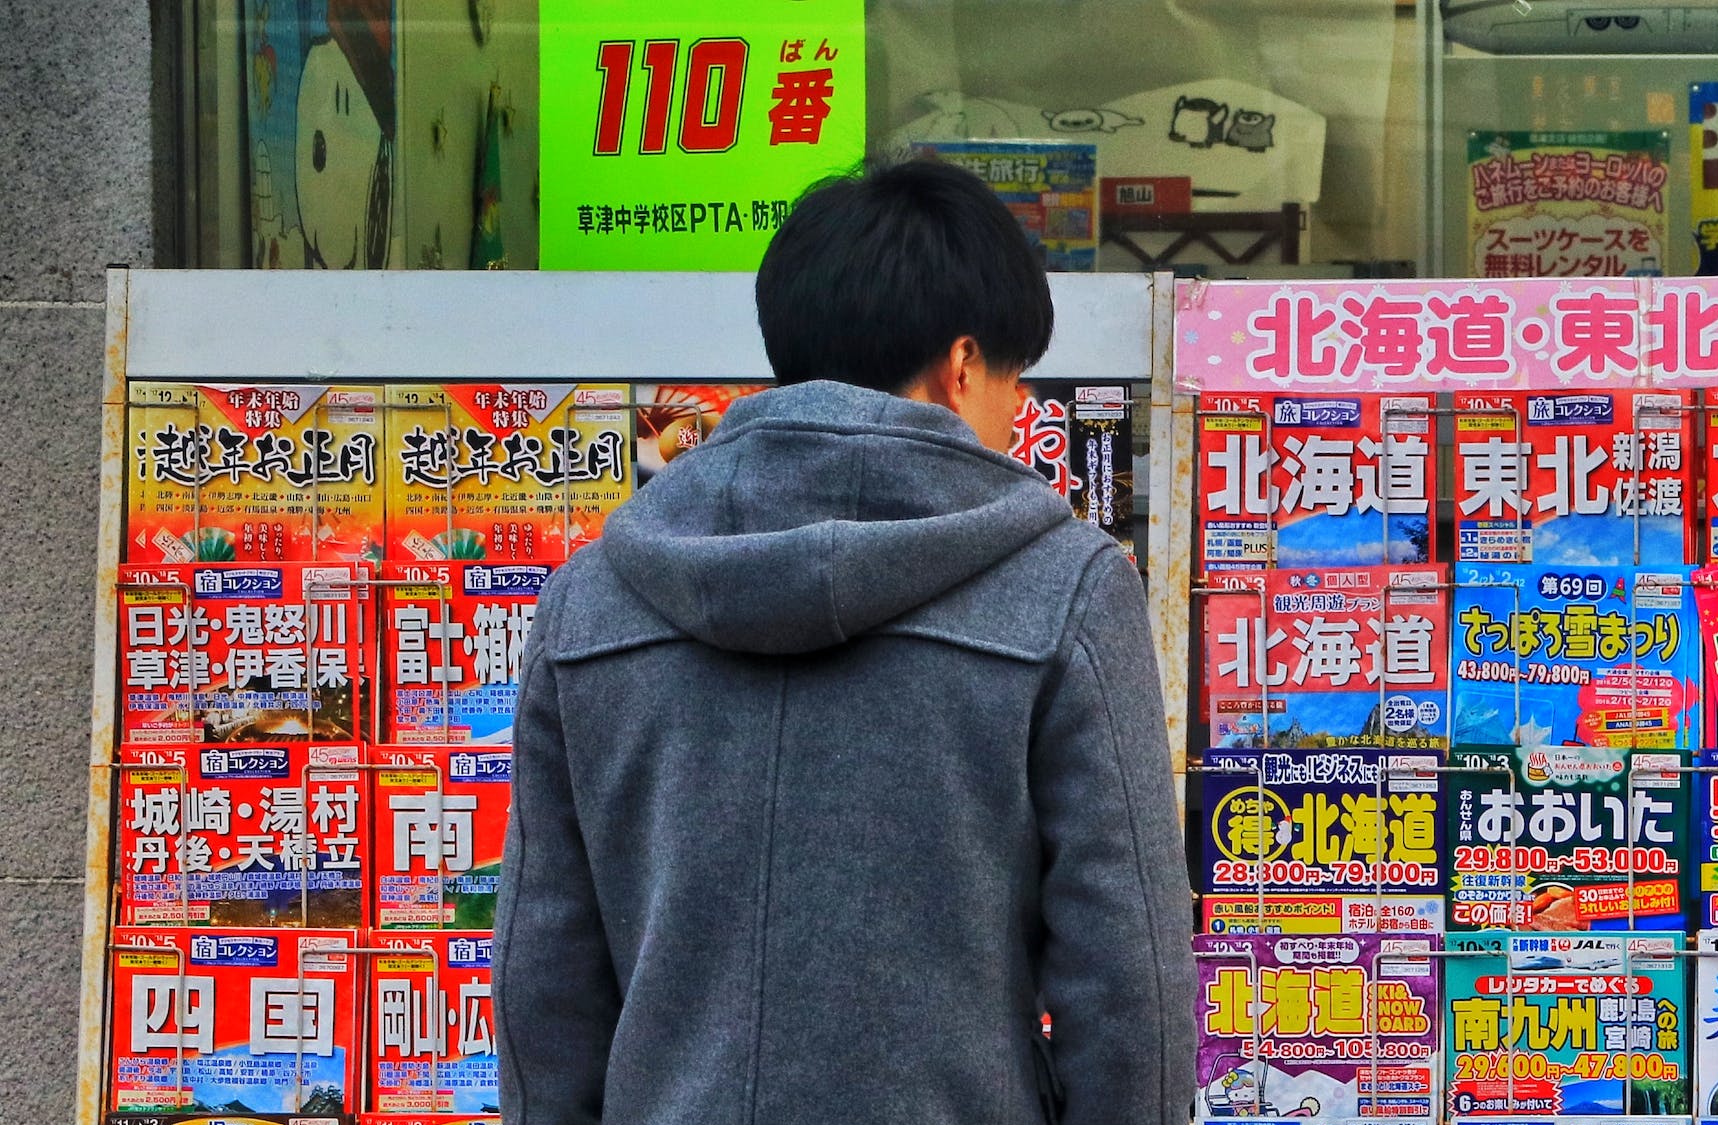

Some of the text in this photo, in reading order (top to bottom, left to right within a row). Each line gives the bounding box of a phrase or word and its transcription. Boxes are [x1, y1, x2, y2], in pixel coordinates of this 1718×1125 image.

[780, 37, 838, 61] ばん
[1487, 228, 1649, 252] スーツケースを
[229, 391, 299, 409] 年末年始
[474, 390, 546, 412] 年末年始
[245, 412, 281, 428] 特集
[492, 410, 529, 429] 特集
[1207, 435, 1429, 515] 北海道
[1460, 436, 1610, 516] 東北
[1217, 616, 1435, 687] 北海道
[127, 649, 349, 689] 草津・伊香保
[1293, 794, 1437, 864] 北海道
[1208, 970, 1364, 1037] 北海道
